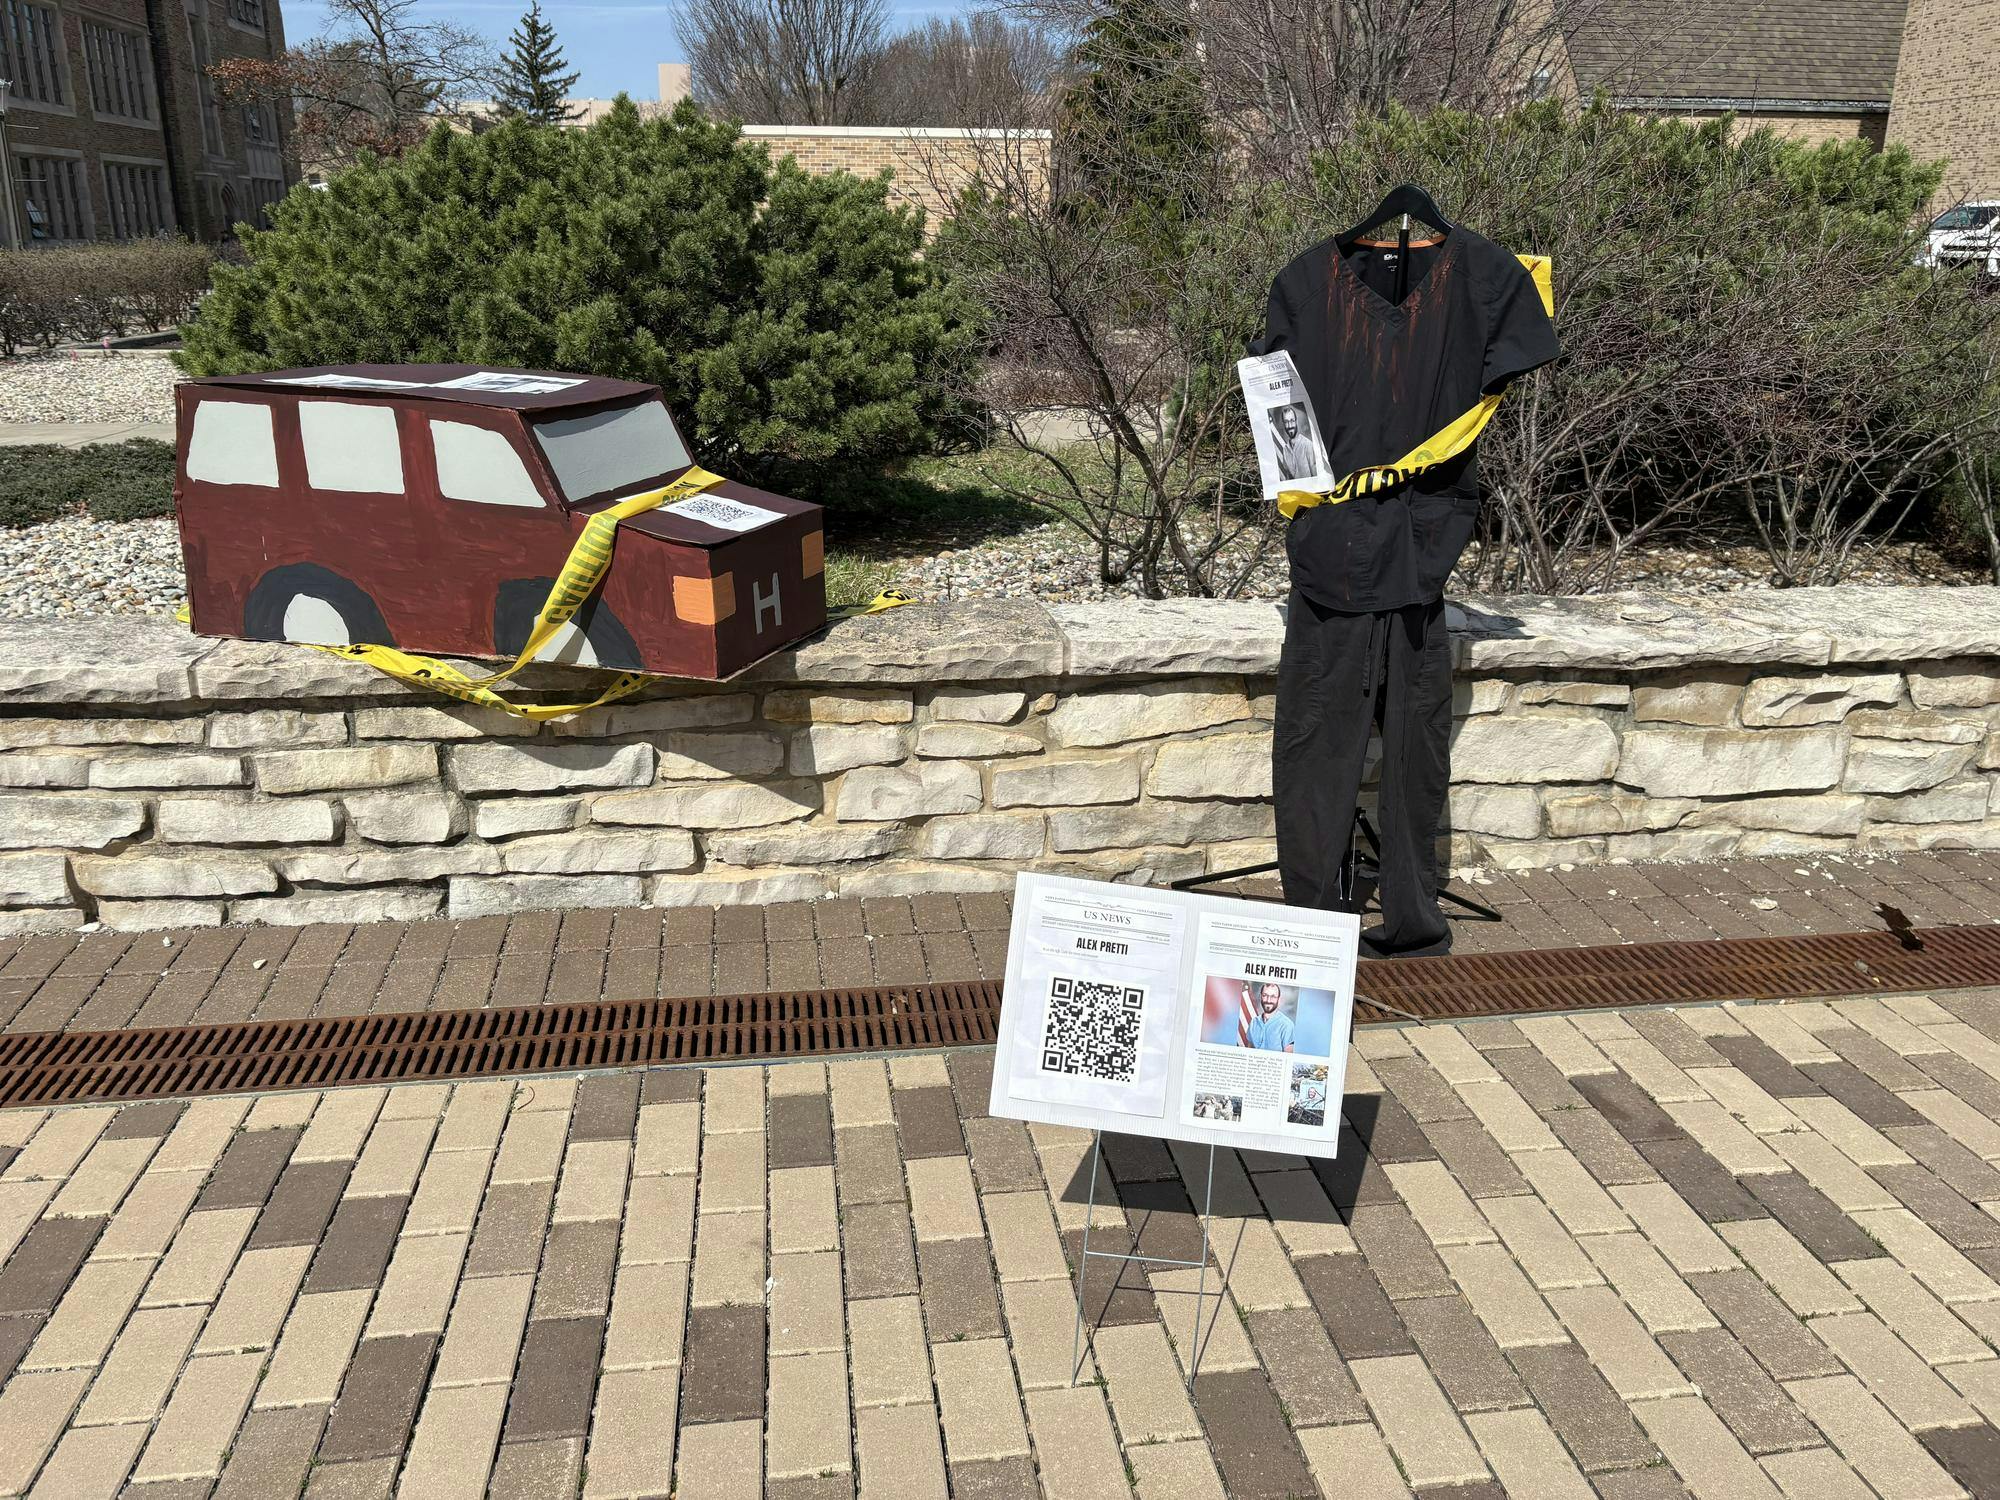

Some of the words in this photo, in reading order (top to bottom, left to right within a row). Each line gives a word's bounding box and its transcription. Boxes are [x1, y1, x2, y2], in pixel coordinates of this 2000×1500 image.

[1269, 379, 1281, 391] ALEX
[753, 572, 782, 635] H
[1084, 910, 1098, 920] US
[1100, 913, 1132, 925] NEWS
[1076, 937, 1098, 951] ALEX
[1100, 940, 1129, 955] PRETTI
[1251, 935, 1265, 945] US
[1268, 937, 1299, 949] NEWS
[1245, 962, 1266, 976] ALEX
[1268, 965, 1298, 980] PRETTI
